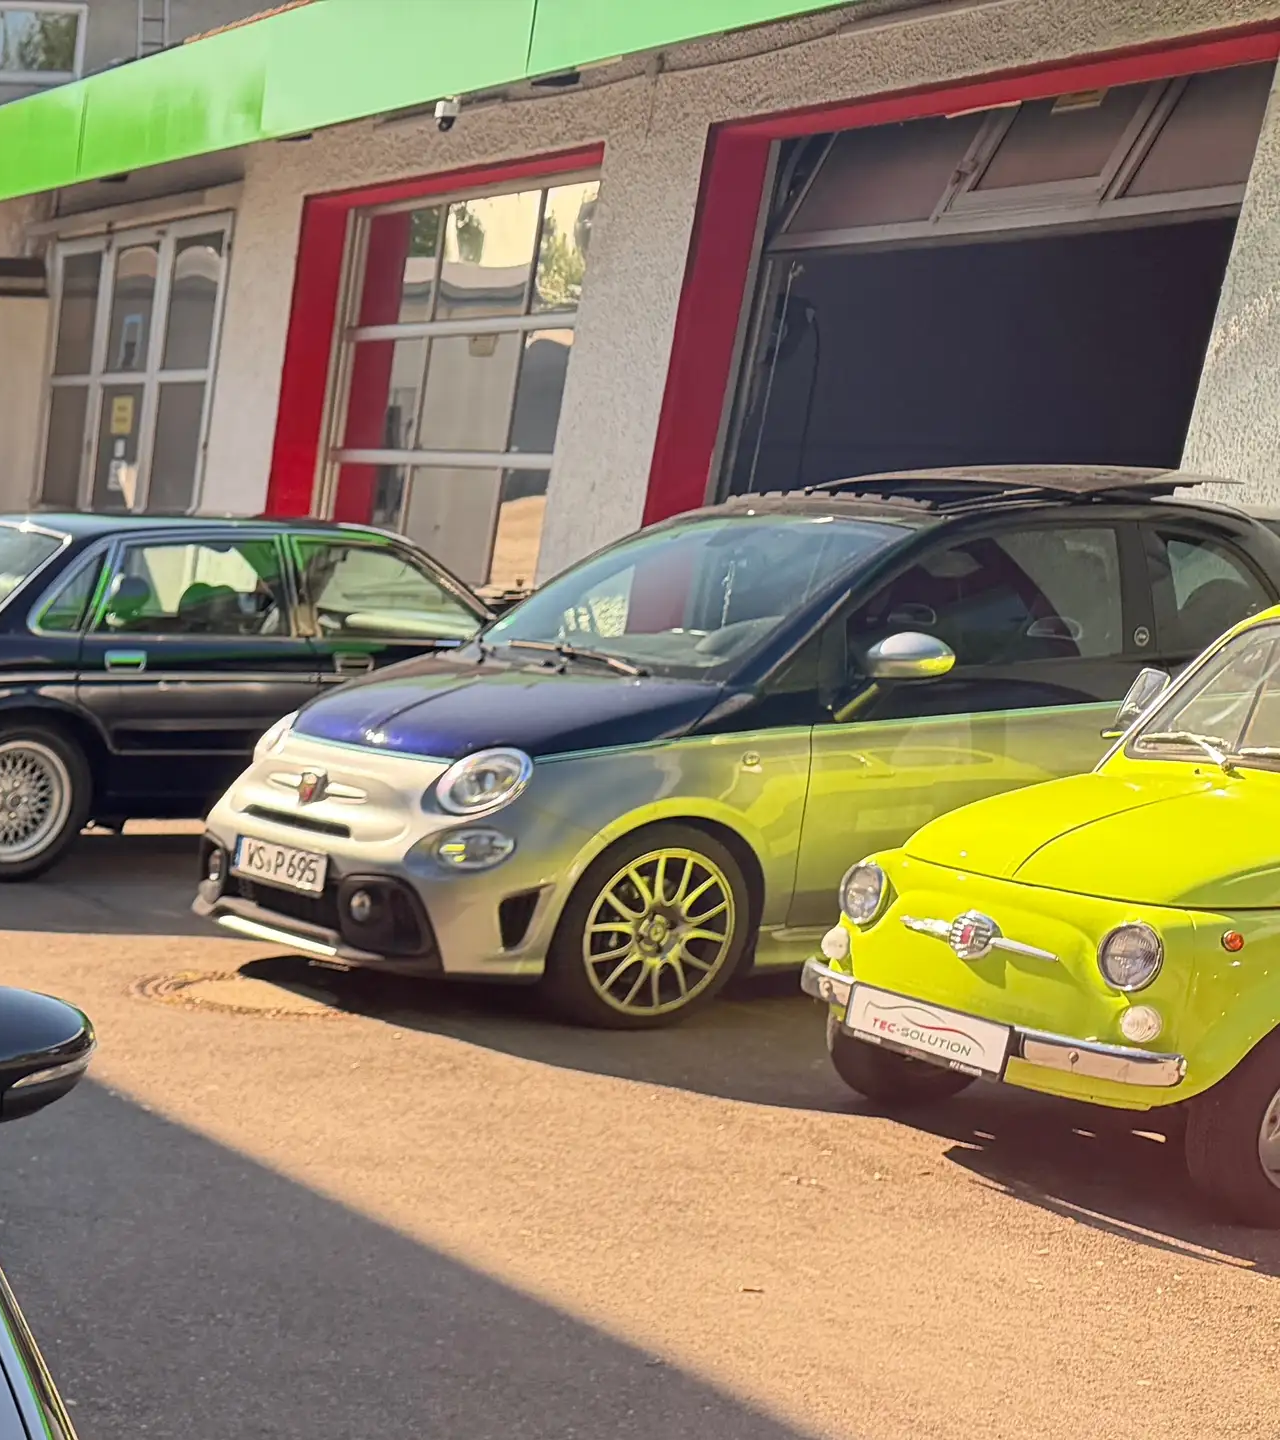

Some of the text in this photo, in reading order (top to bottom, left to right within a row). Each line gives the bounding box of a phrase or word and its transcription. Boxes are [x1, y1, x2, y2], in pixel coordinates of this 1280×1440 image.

[273, 850, 285, 875] P
[286, 852, 319, 882] 695
[872, 1017, 972, 1057] TEC-SOLUTION
